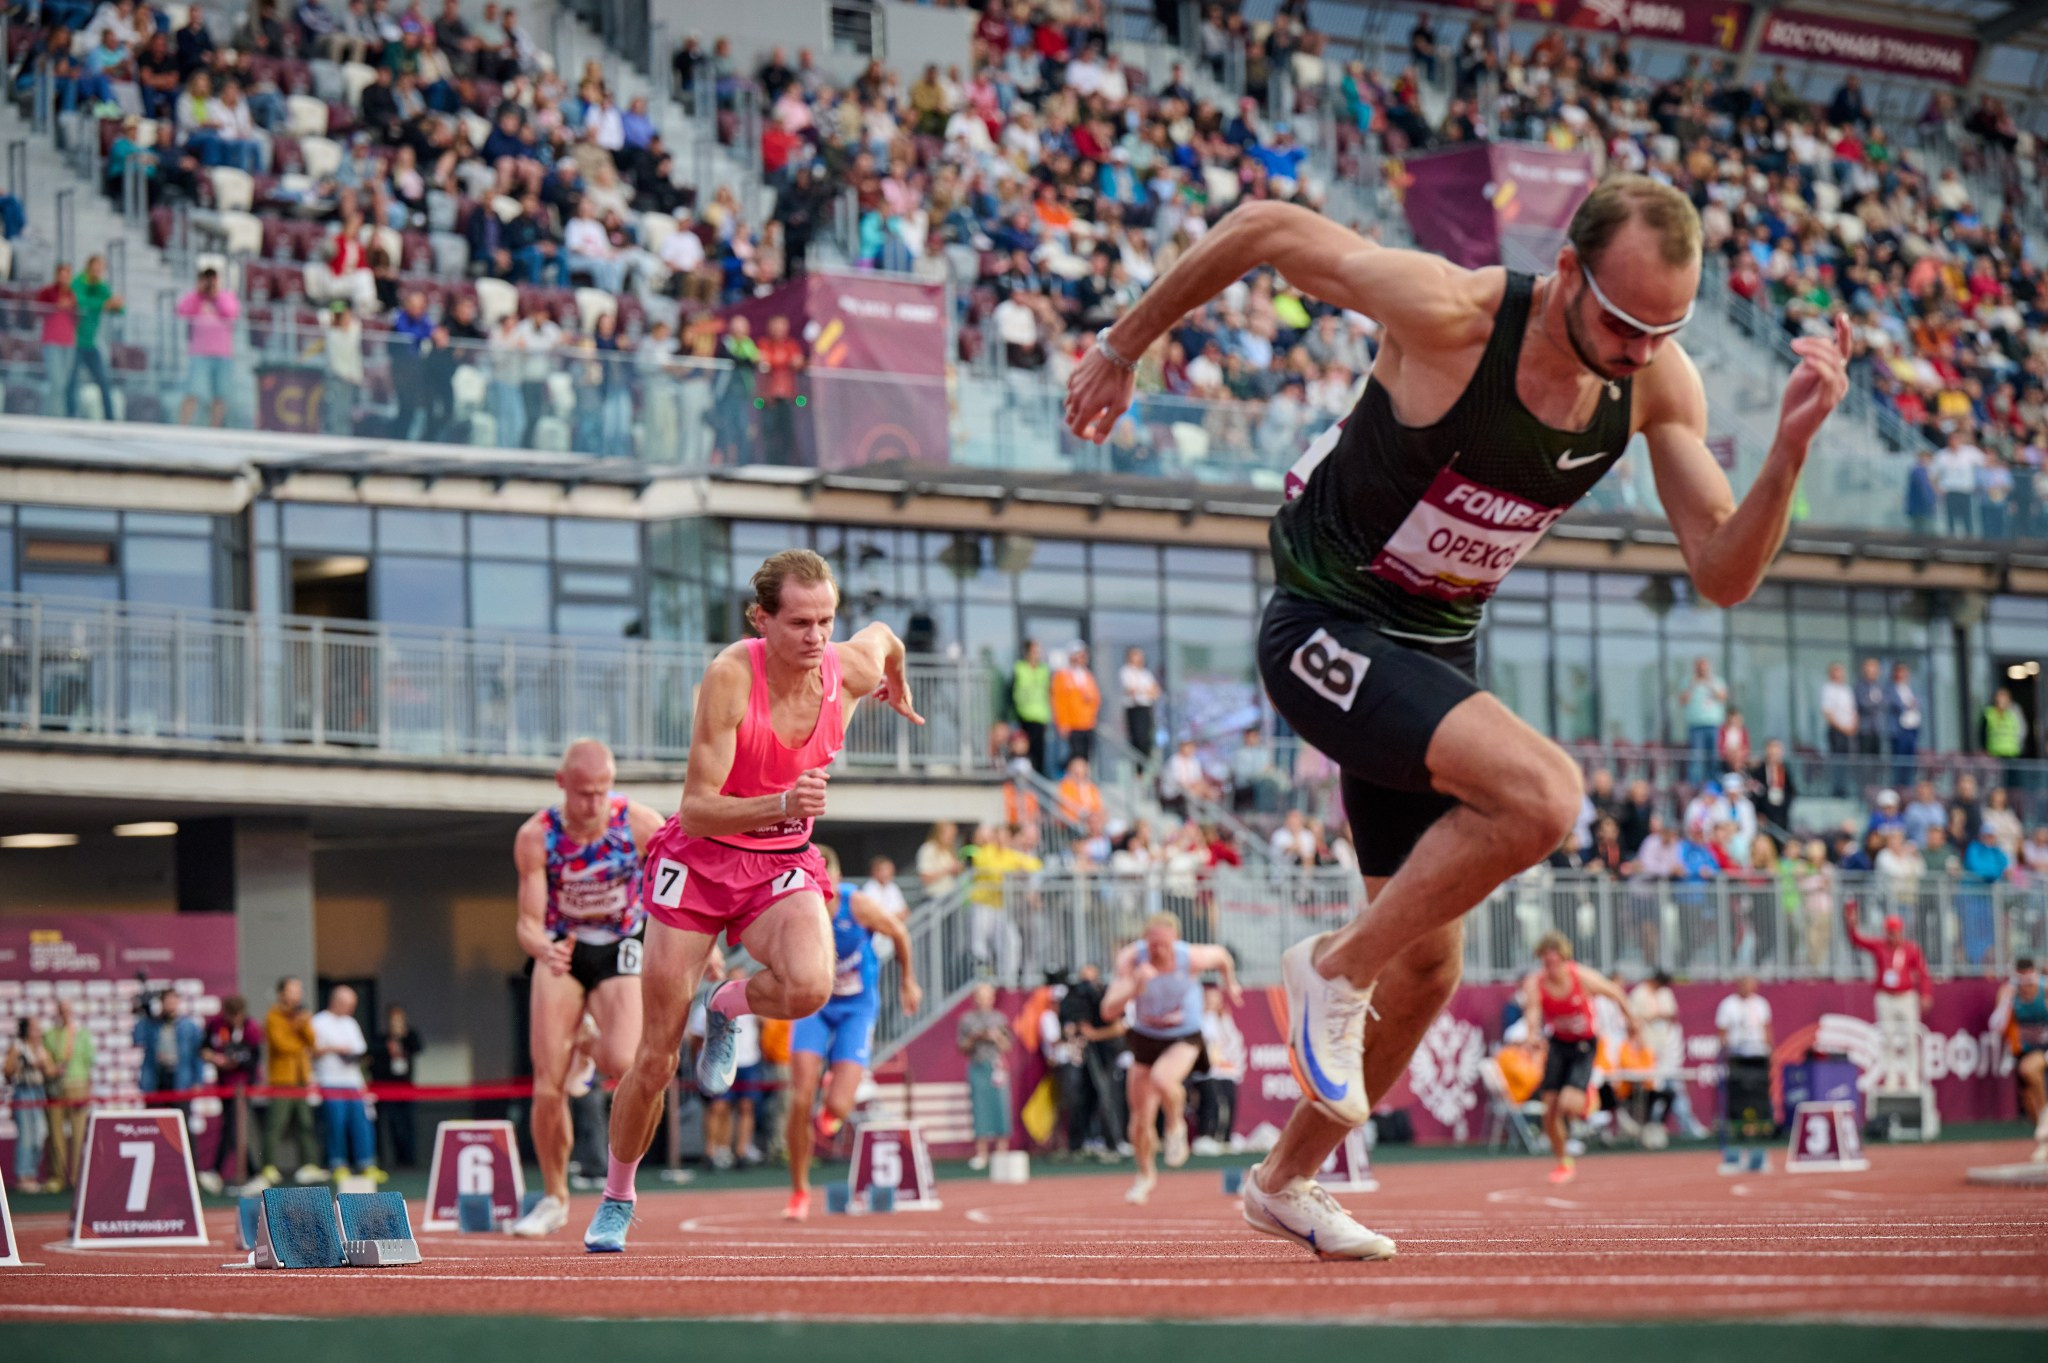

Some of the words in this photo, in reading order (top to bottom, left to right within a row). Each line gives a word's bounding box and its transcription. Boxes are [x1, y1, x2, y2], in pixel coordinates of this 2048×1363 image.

[1301, 642, 1354, 696] 8
[660, 867, 680, 896] 7
[776, 869, 797, 889] 7
[625, 944, 637, 968] 6
[1805, 1114, 1831, 1156] 3
[119, 1141, 155, 1212] 7
[457, 1144, 494, 1195] 6
[871, 1140, 903, 1188] 5
[92, 1218, 186, 1234] ЕКАТЕРИНБУРГ
